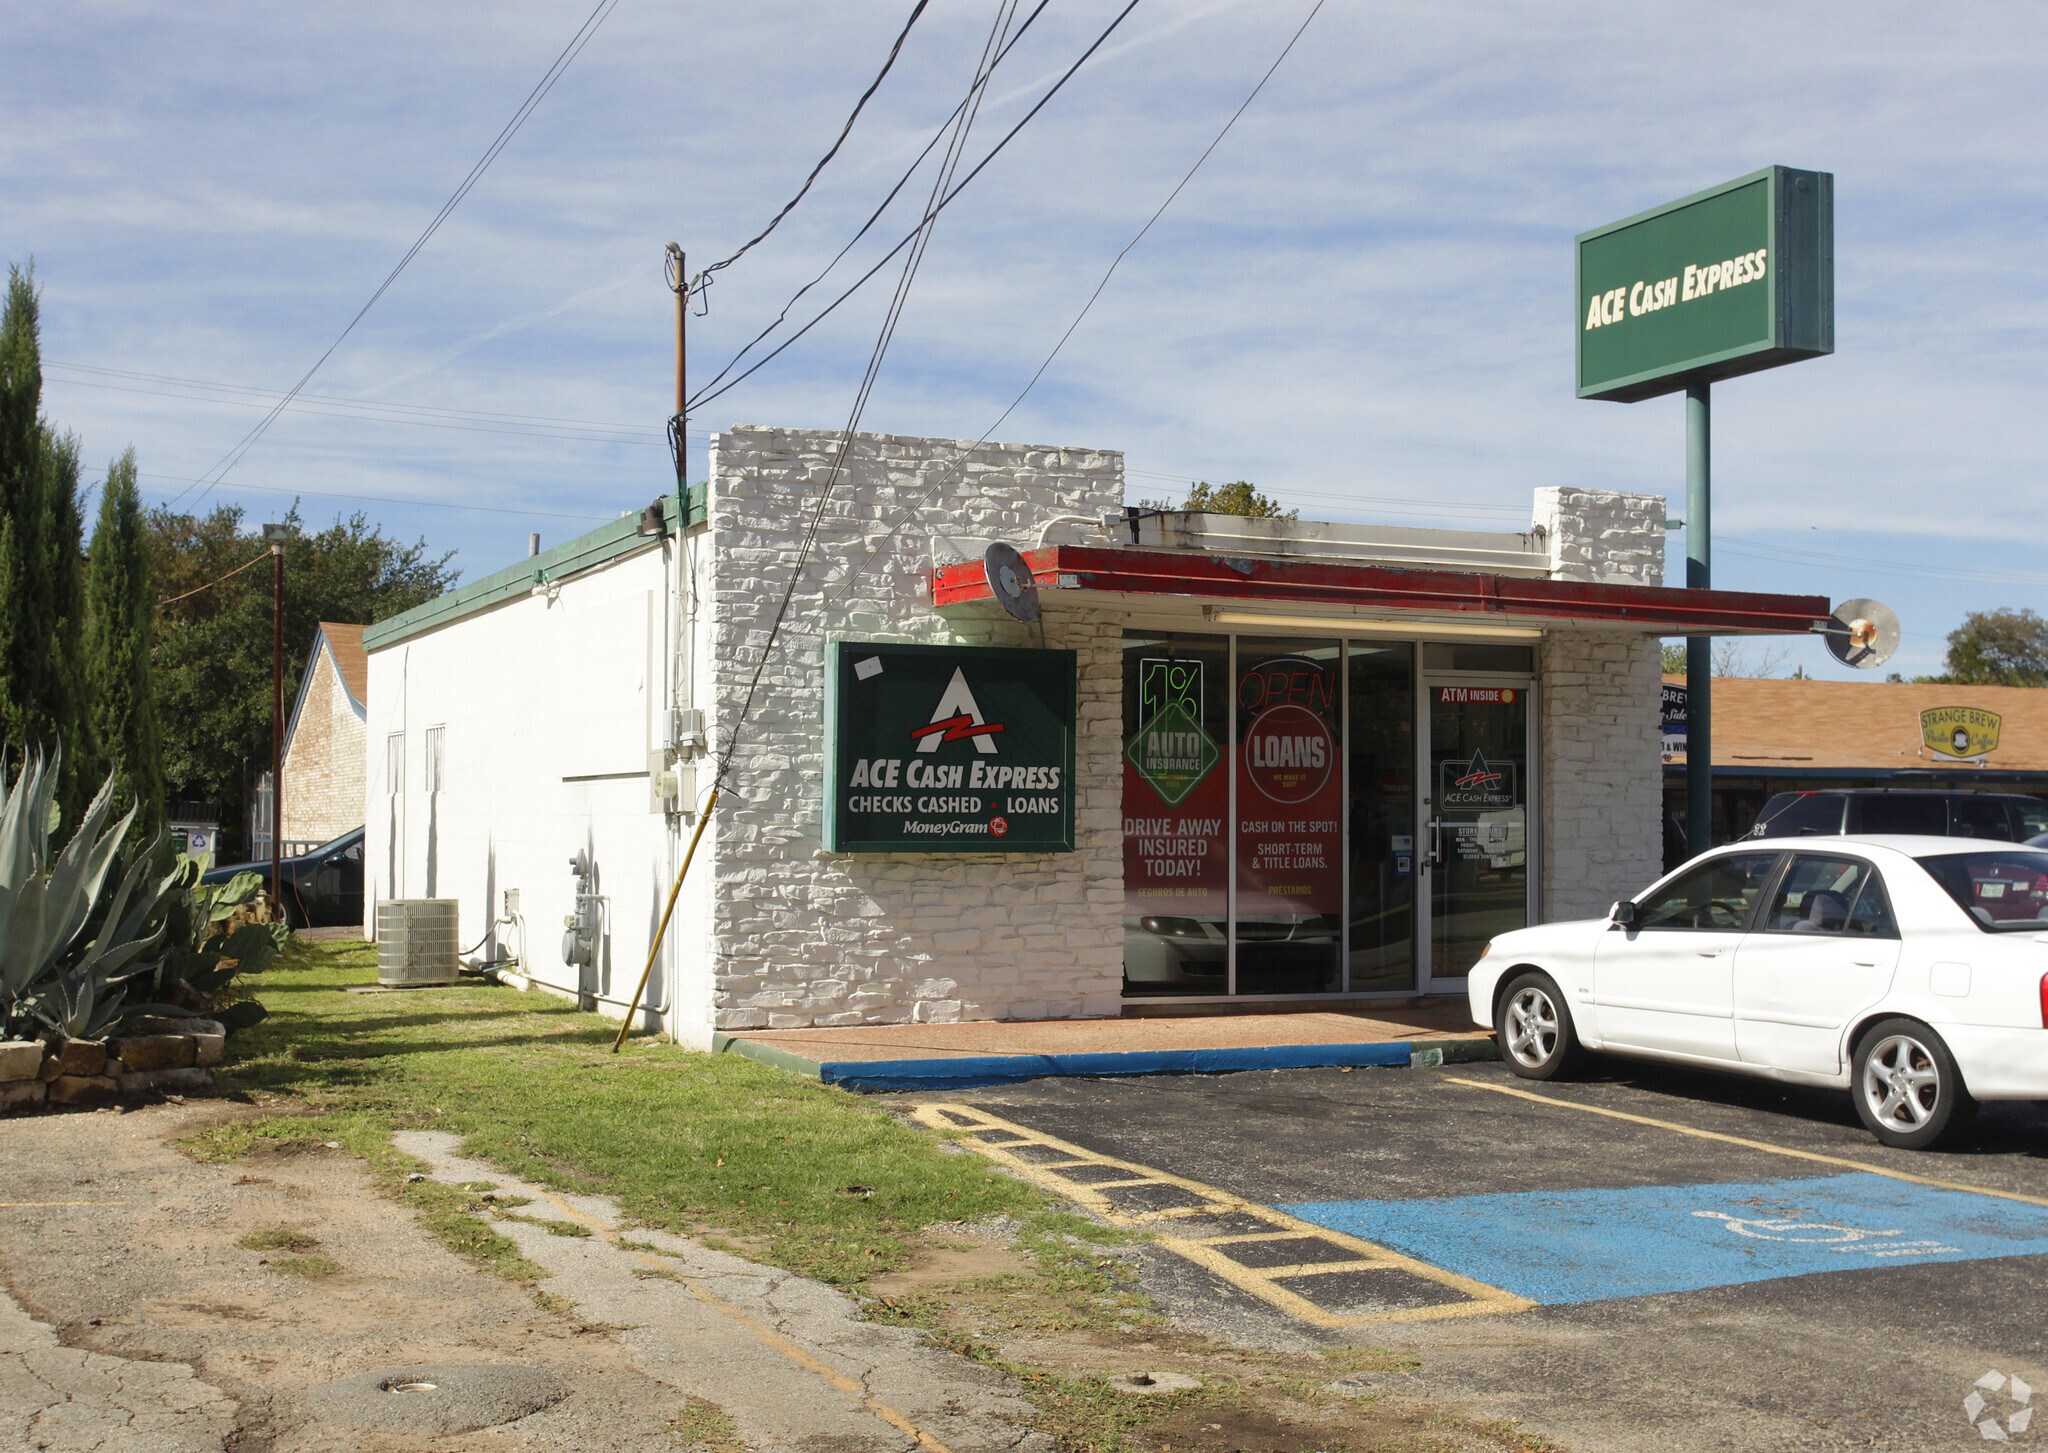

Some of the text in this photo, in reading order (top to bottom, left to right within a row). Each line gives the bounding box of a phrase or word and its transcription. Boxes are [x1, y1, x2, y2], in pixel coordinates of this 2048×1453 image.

[1586, 249, 1766, 330] ACE CASH EXPRESS
[1238, 671, 1335, 709] OPEN
[1441, 688, 1499, 702] ATM INSIDE
[1921, 709, 1998, 729] STRANGE BREW
[1147, 732, 1200, 758] AUTO
[1253, 735, 1325, 768] LOANS
[1146, 758, 1200, 771] INSURANCE
[850, 758, 1061, 790] ACE CASH EXPRESS
[848, 796, 1059, 814] CHECKS CASHED LOANS
[1444, 793, 1462, 803] ACE
[1463, 793, 1482, 803] CASH
[903, 820, 989, 836] MoneyGram
[1124, 818, 1222, 836] DRIVE AWAY
[1241, 821, 1338, 833] CASH ON THE SPOT!
[1138, 839, 1208, 857] INSURED
[1257, 842, 1323, 855] SHORT-TERM
[1144, 859, 1201, 877] TODAY!
[1252, 857, 1328, 869] & TITLE LOANS.
[1137, 887, 1208, 897] SEGUROS DE AUTO
